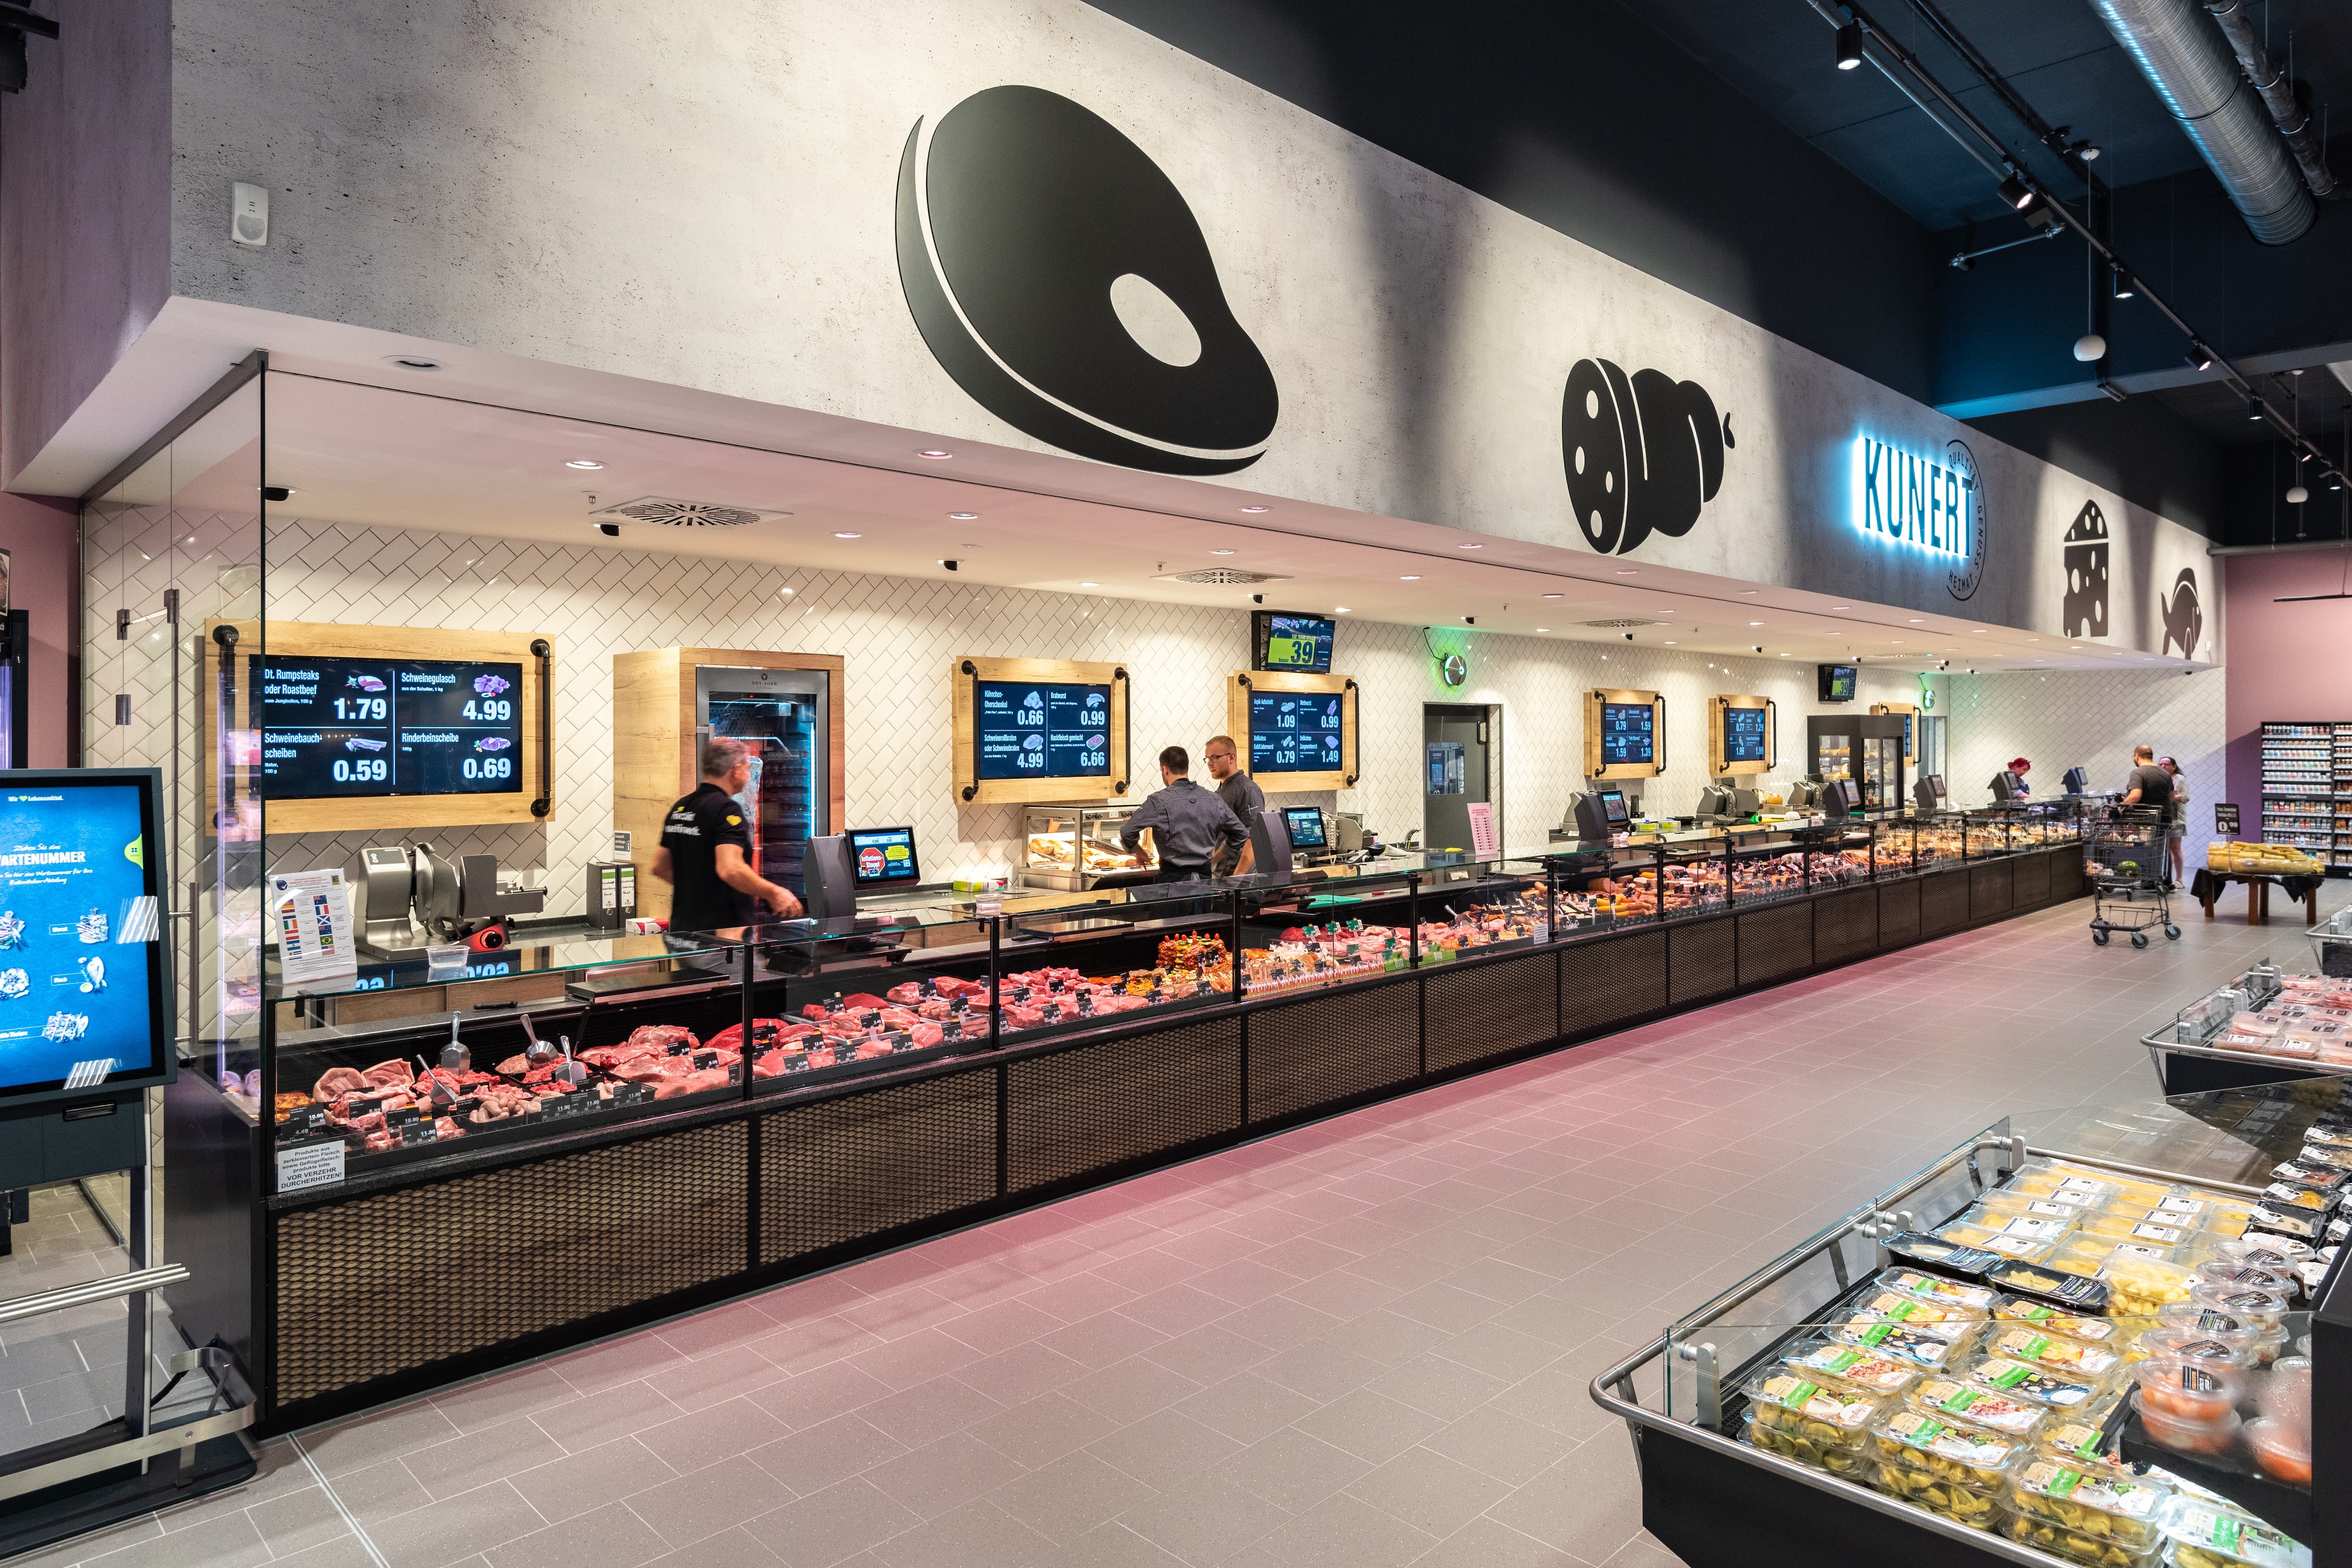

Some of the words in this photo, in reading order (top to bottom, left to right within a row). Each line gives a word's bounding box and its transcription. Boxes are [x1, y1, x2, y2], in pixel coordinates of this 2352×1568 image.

[1948, 452, 1979, 491] QUALITÄT
[1865, 437, 1972, 557] KUNERT
[1974, 505, 1983, 570] GENUSS
[1949, 569, 1974, 592] HEIMAT
[1291, 641, 1313, 663] 39
[265, 669, 275, 679] Dt.
[277, 669, 319, 681] Rumpsteaks
[402, 673, 456, 685] Schweinegulasch
[265, 685, 281, 694] oder
[282, 685, 317, 694] Roastbeef
[1840, 682, 1848, 695] 39
[334, 698, 387, 719] 1.79
[463, 700, 511, 720] 4.99
[1017, 710, 1043, 725] 0.66
[1081, 711, 1105, 725] 0.99
[1277, 715, 1295, 727] 1.09
[1321, 716, 1338, 728] 0.99
[1616, 721, 1626, 730] 0.79
[1641, 721, 1651, 731] 1.59
[265, 733, 323, 743] Schweinebauch-
[402, 733, 459, 742] Rinderbeinscheibe
[265, 748, 296, 757] scheiben
[1276, 751, 1295, 763] 0.79
[1321, 750, 1339, 763] 1.49
[1616, 748, 1626, 757] 1.59
[1641, 748, 1651, 757] 1.39
[1017, 753, 1043, 768] 4.99
[1081, 752, 1105, 766] 6.66
[333, 760, 387, 781] 0.59
[463, 758, 511, 778] 0.69
[1433, 951, 1442, 961] BIO
[1395, 959, 1404, 968] BIO
[295, 1148, 319, 1156] Produkte
[283, 1154, 319, 1164] zerkleinertem
[300, 1155, 341, 1167] Geflügelfleisch-
[304, 1167, 336, 1178] VERZEHR
[281, 1172, 342, 1189] DURCHERHITZEN!
